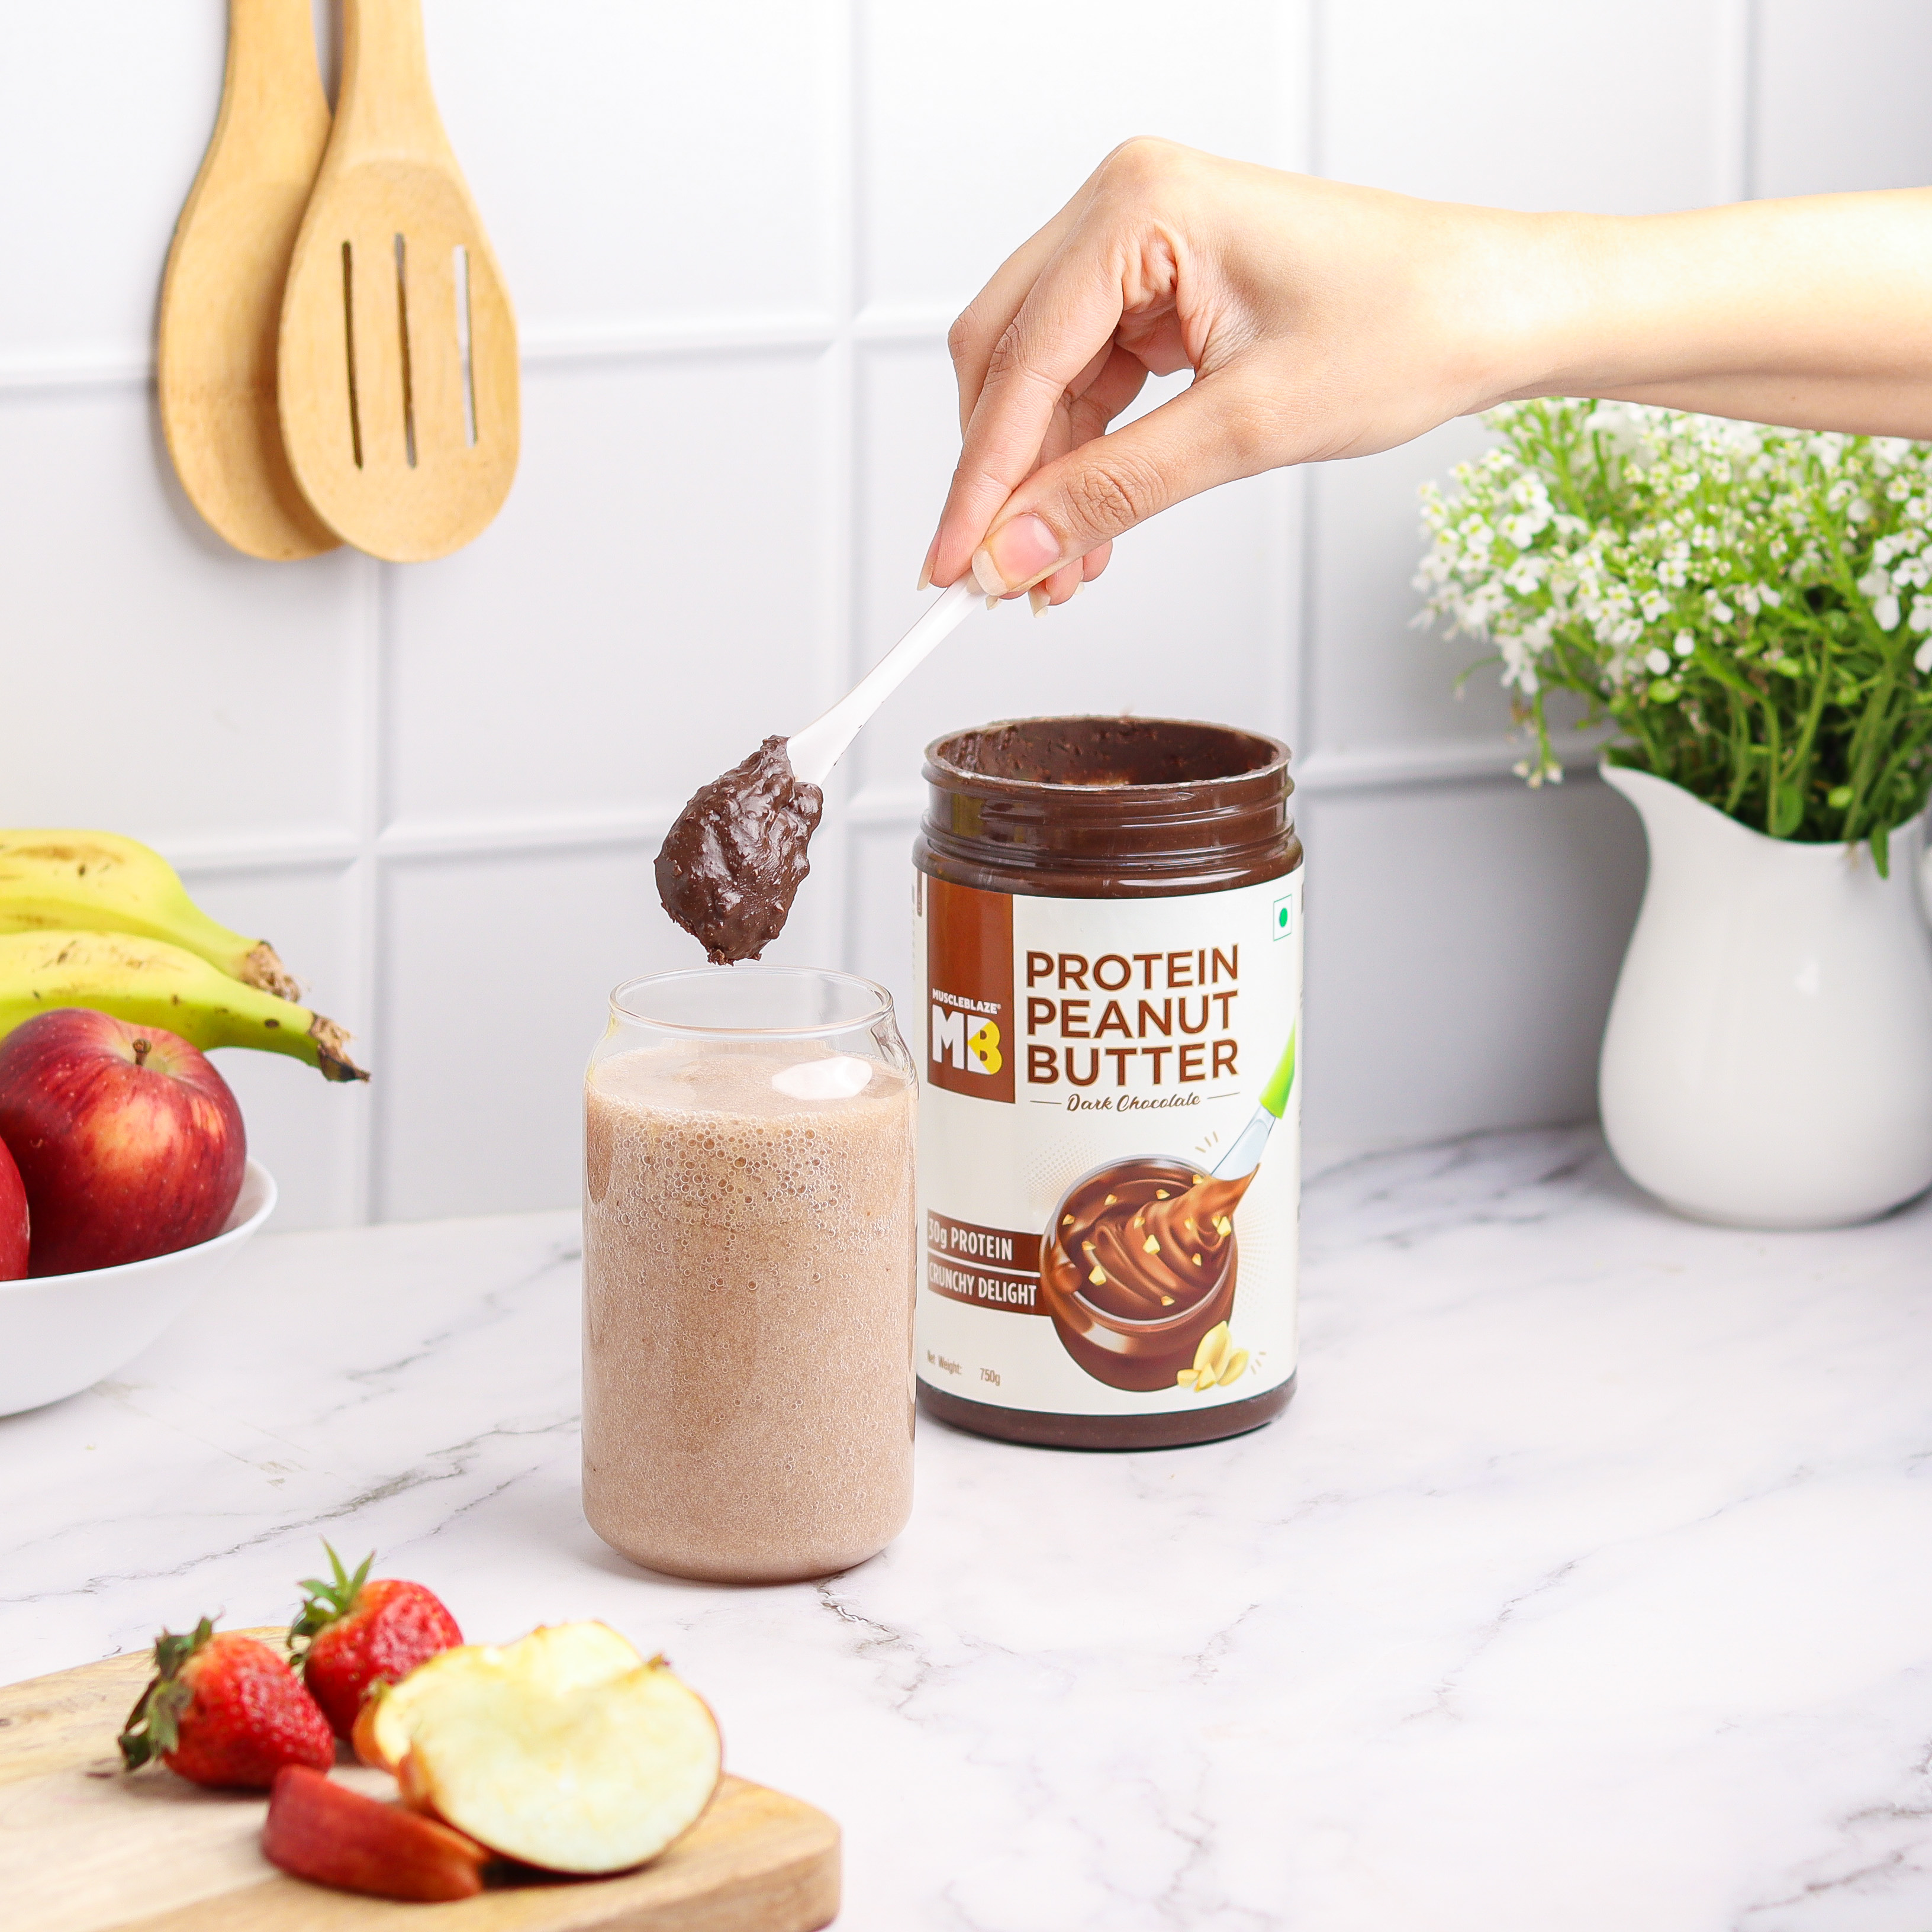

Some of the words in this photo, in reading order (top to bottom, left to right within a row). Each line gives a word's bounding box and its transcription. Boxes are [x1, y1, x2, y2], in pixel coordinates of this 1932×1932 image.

[1026, 943, 1239, 991] PROTEIN
[1026, 990, 1238, 1039] PEANUT
[932, 1004, 1003, 1076] MB
[1026, 1038, 1239, 1087] BUTTER
[1067, 1093, 1113, 1112] Dark
[1116, 1091, 1201, 1112] Chocolate
[928, 1218, 948, 1250] 30g
[951, 1226, 1013, 1261] PROTEIN
[928, 1261, 975, 1296] CRUNCHY
[978, 1277, 1037, 1306] DELIGHT
[980, 1367, 1000, 1386] 750g
